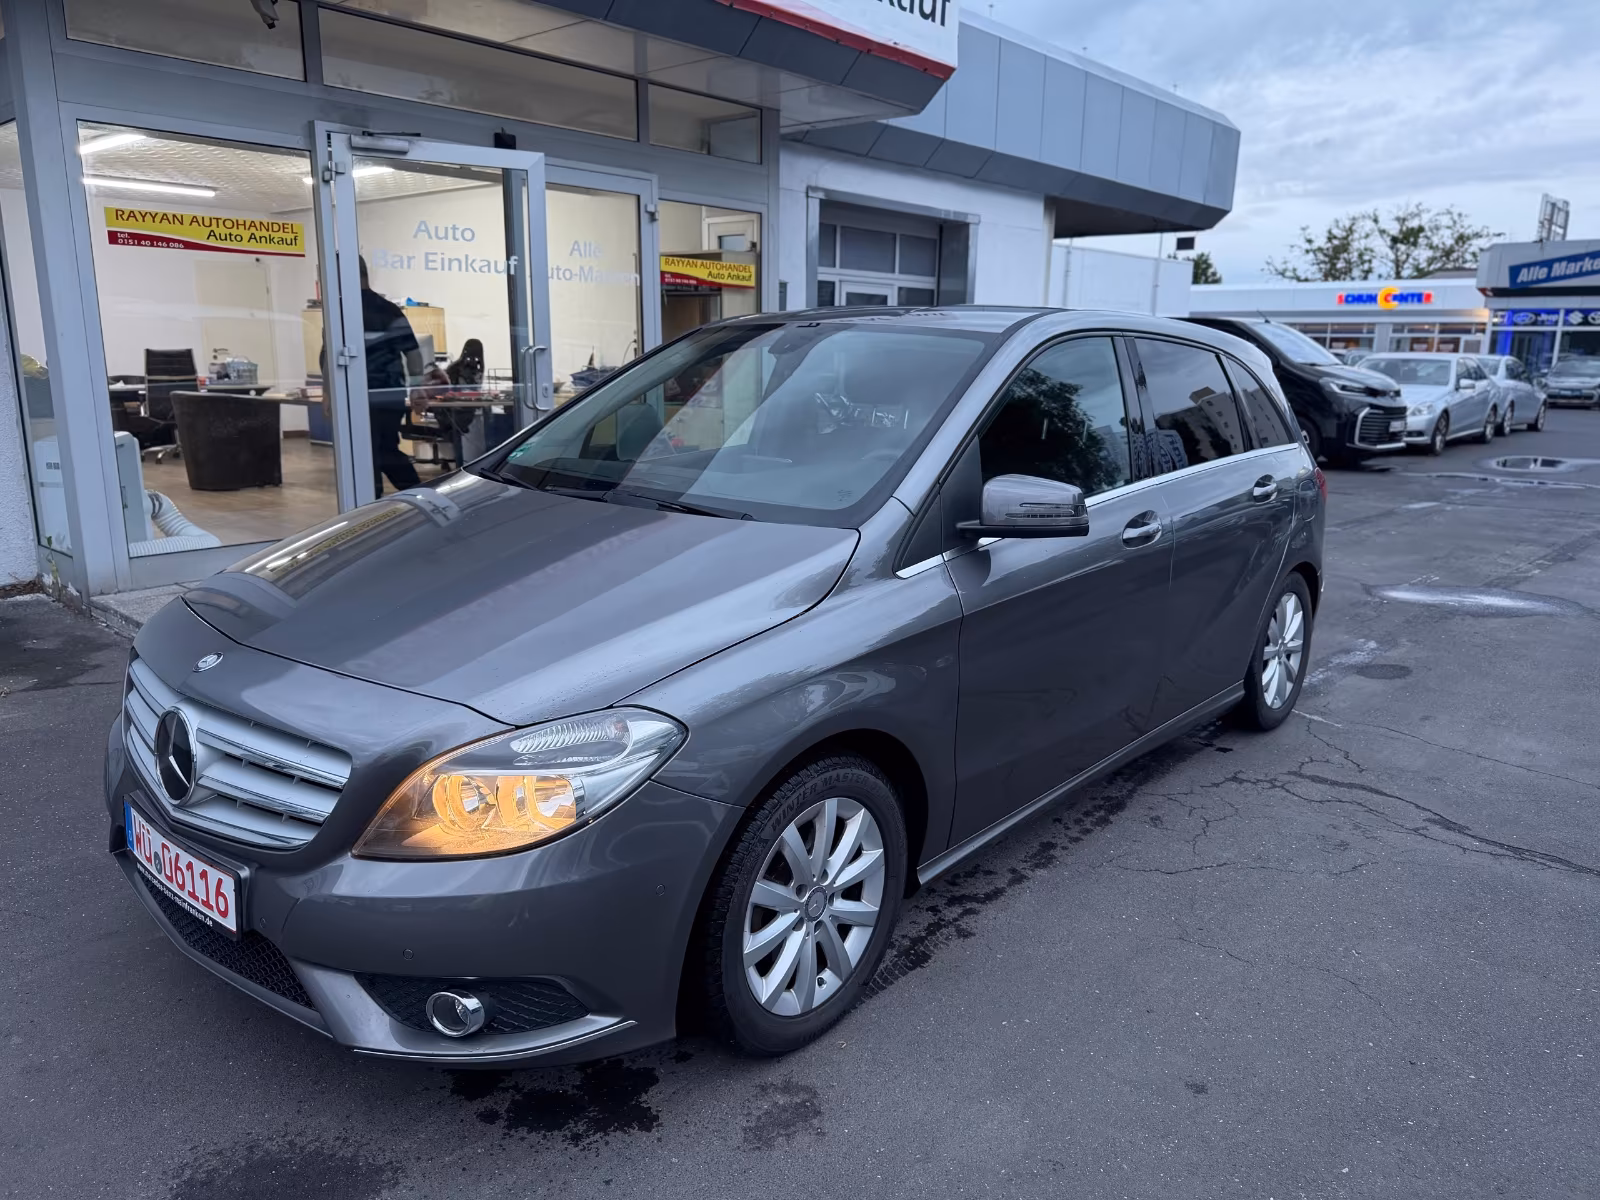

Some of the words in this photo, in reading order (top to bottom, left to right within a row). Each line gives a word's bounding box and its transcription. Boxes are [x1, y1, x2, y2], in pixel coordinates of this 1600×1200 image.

[115, 209, 184, 226] RAYYAN
[189, 216, 298, 234] AUTOHANDEL
[206, 229, 243, 243] Auto
[247, 232, 299, 247] Ankauf
[413, 220, 476, 242] Auto
[117, 238, 138, 246] 0151
[153, 240, 168, 248] 146
[169, 241, 185, 249] 086
[569, 240, 603, 258] Alle
[371, 248, 416, 271] Bar
[424, 251, 519, 275] Einkauf
[664, 257, 698, 269] RAYYAN
[699, 260, 753, 274] AUTOHANDEL
[706, 270, 725, 280] Auto
[726, 272, 753, 282] Ankauf
[1517, 266, 1548, 283] Alle
[772, 784, 818, 831] WINTER
[132, 812, 153, 867] WÜ
